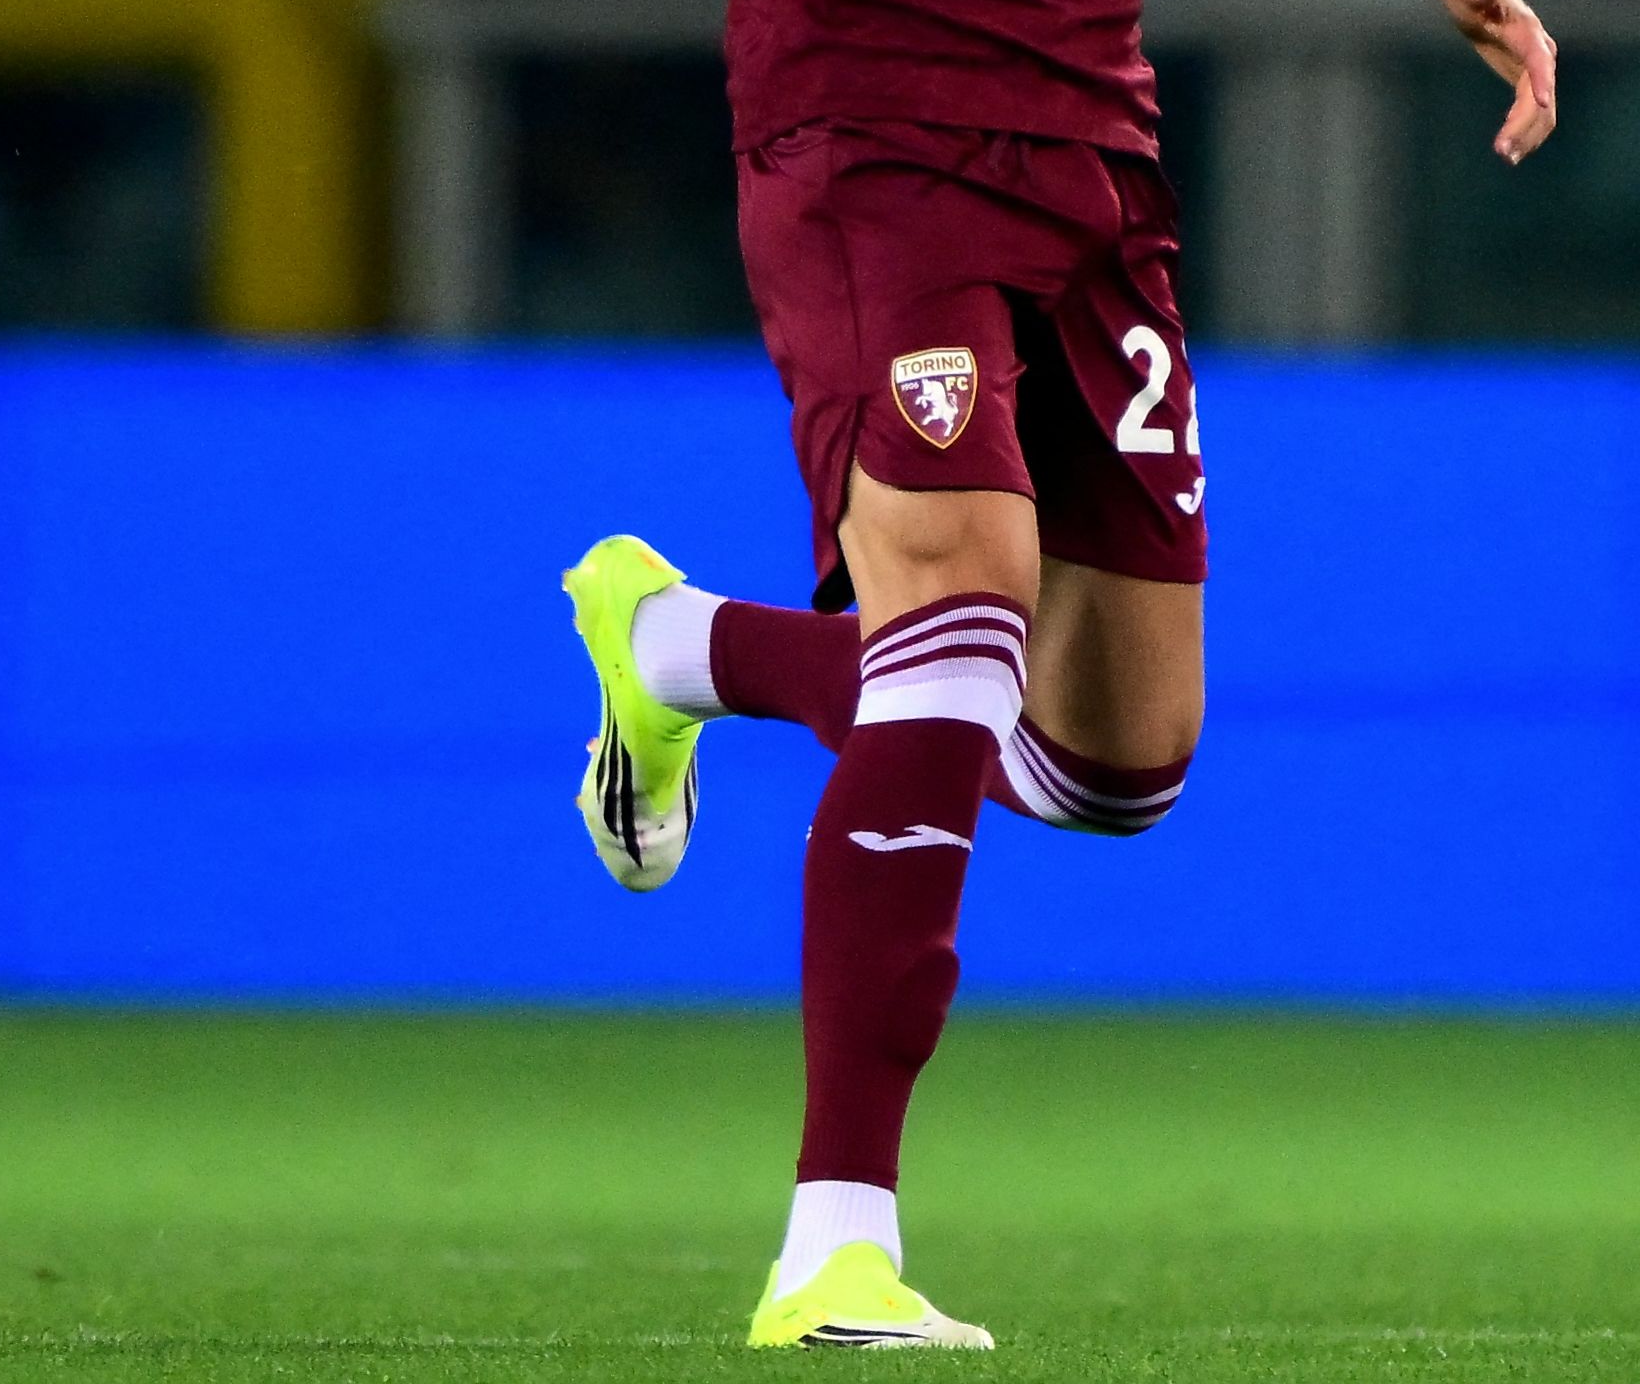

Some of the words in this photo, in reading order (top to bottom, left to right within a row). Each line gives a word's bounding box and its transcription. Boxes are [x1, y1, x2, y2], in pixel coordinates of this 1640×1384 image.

[899, 354, 967, 377] TORINO
[944, 376, 969, 391] FC
[1116, 325, 1201, 455] 2
